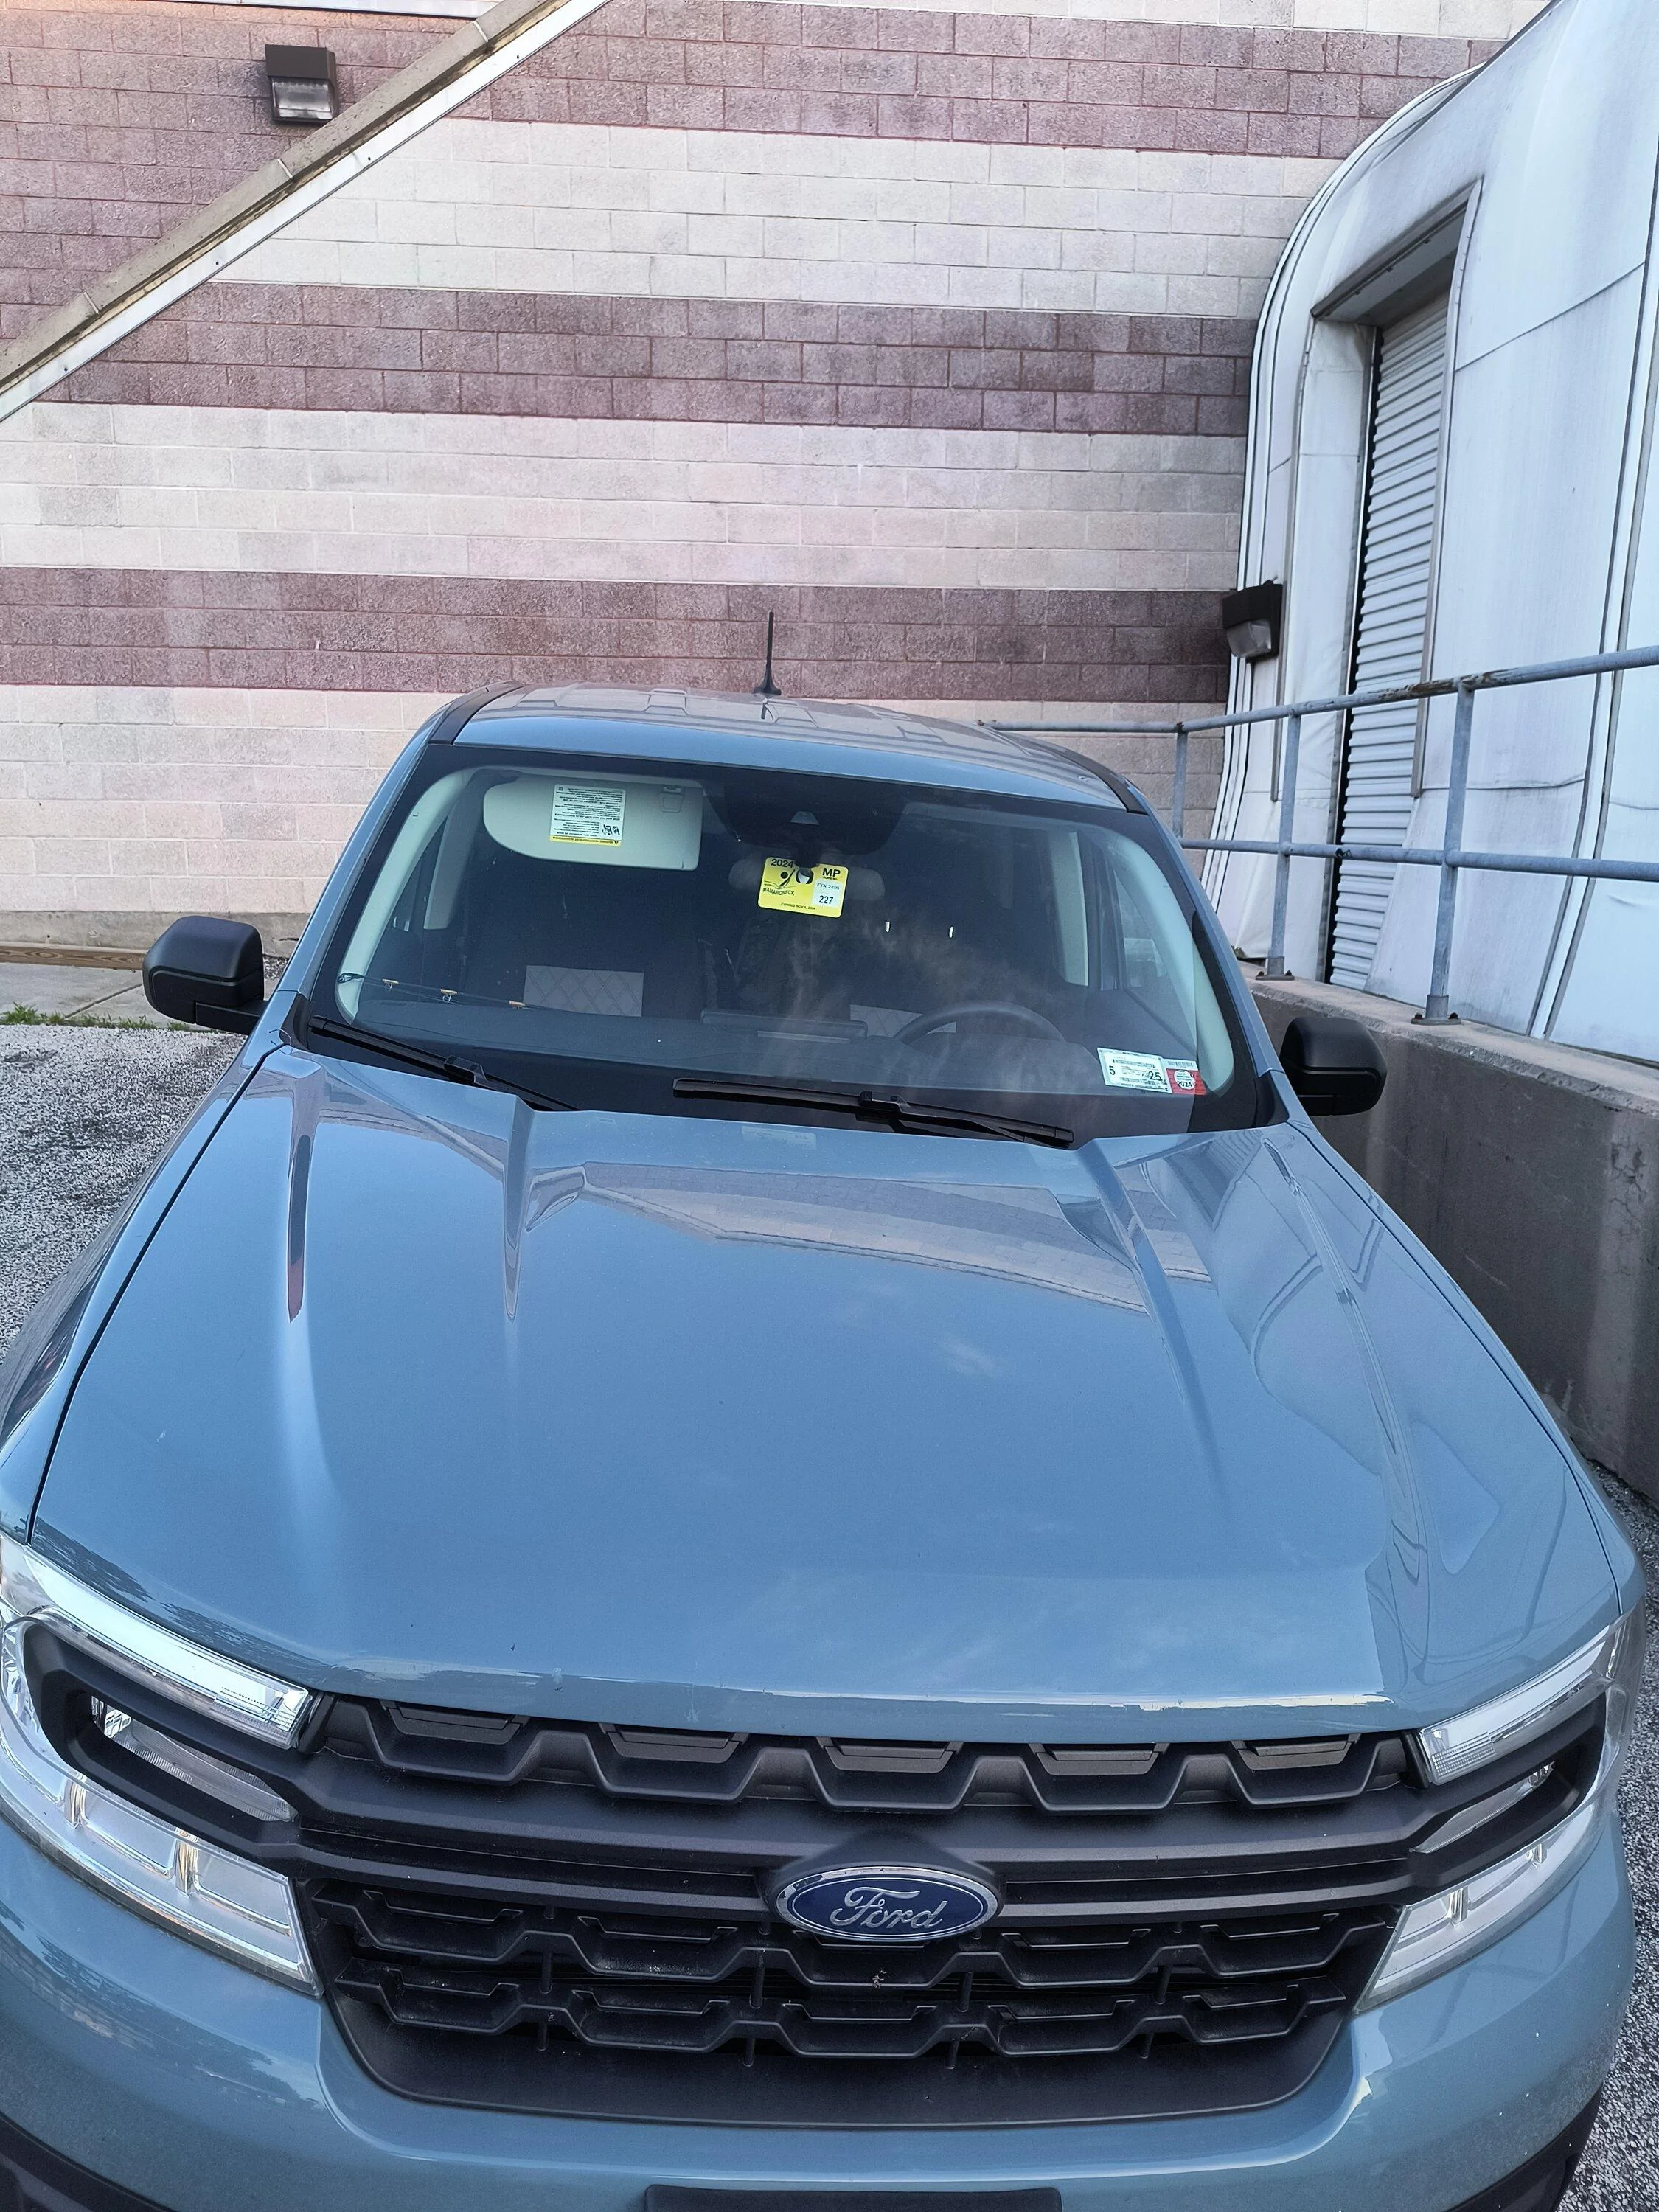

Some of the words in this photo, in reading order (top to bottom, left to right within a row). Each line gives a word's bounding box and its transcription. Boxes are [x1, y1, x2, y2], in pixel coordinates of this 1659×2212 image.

[771, 858, 793, 868] 2024
[822, 868, 841, 877] MP
[762, 887, 795, 895] MAMARONECK
[818, 895, 833, 904] 227
[1109, 1065, 1116, 1075] 5
[1150, 1071, 1163, 1081] 25
[830, 1886, 948, 1929] Ford
